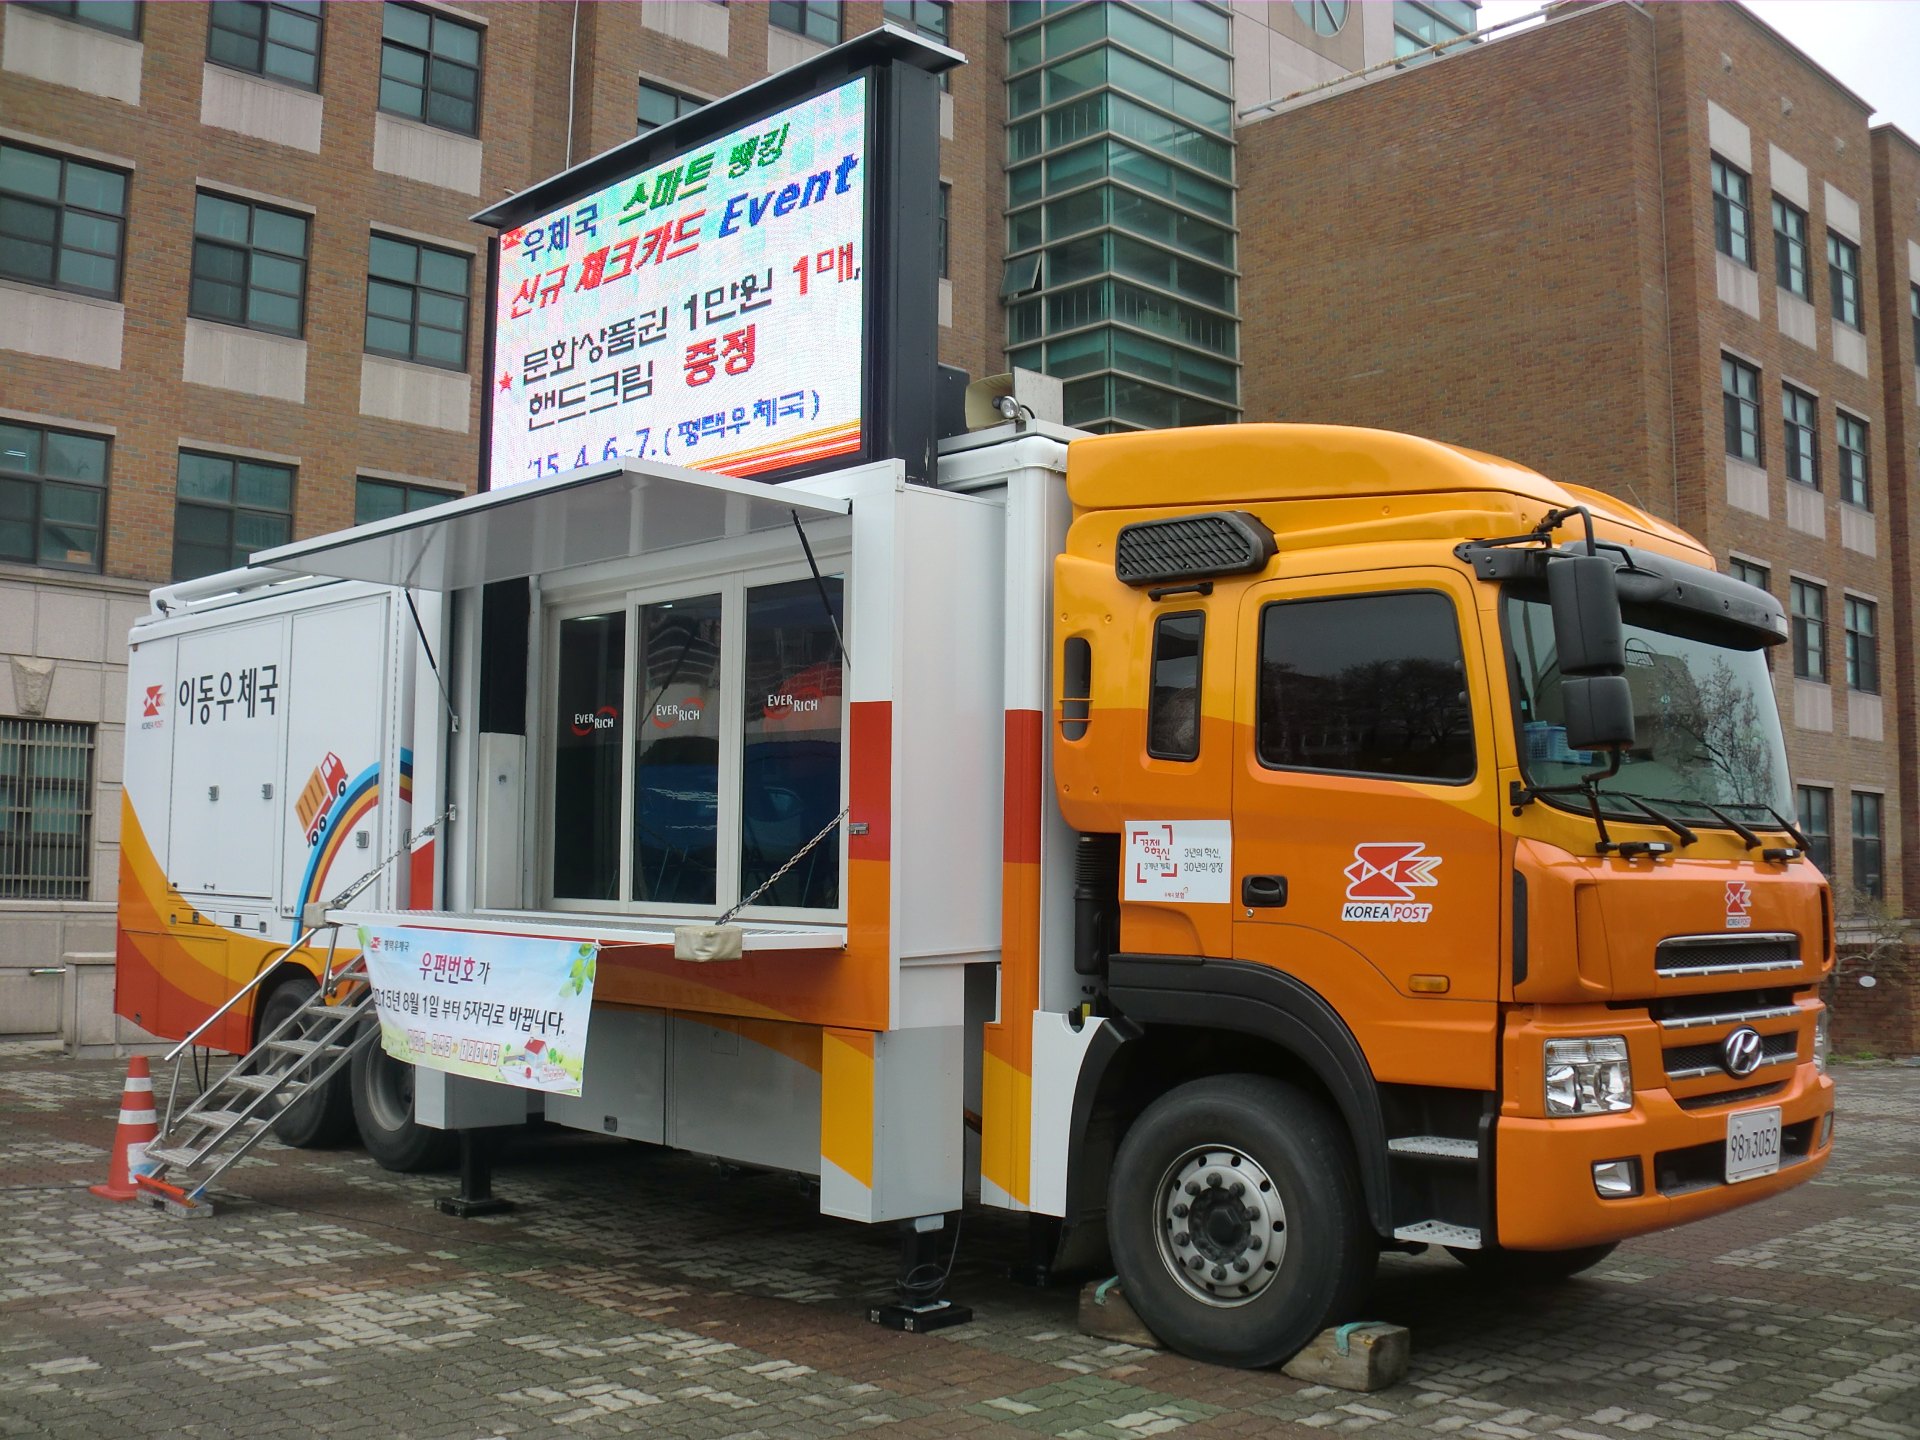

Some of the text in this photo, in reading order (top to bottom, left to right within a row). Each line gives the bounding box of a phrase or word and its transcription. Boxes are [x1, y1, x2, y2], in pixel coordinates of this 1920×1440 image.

[522, 122, 790, 262] 우체국 스마트 뱅킹
[511, 153, 860, 319] 신규 체크카드 Event
[523, 305, 668, 386] 문화상품권
[683, 267, 773, 331] 1만원
[528, 323, 756, 432] 핸드크림 증정
[178, 664, 279, 725] 이동우체국
[793, 699, 818, 712] RICH
[678, 709, 700, 721] RICH
[594, 717, 614, 729] RICH
[1150, 847, 1171, 861] 혁신
[1184, 848, 1203, 858] 3년의
[1183, 862, 1224, 873] 30년의 성장
[1344, 906, 1430, 919] KOREA POST
[402, 992, 419, 1015] 8월
[422, 995, 440, 1018] 1일
[441, 1000, 461, 1021] 부터
[462, 1001, 506, 1026] 5자리로
[509, 1006, 565, 1036] 바뀝니다.
